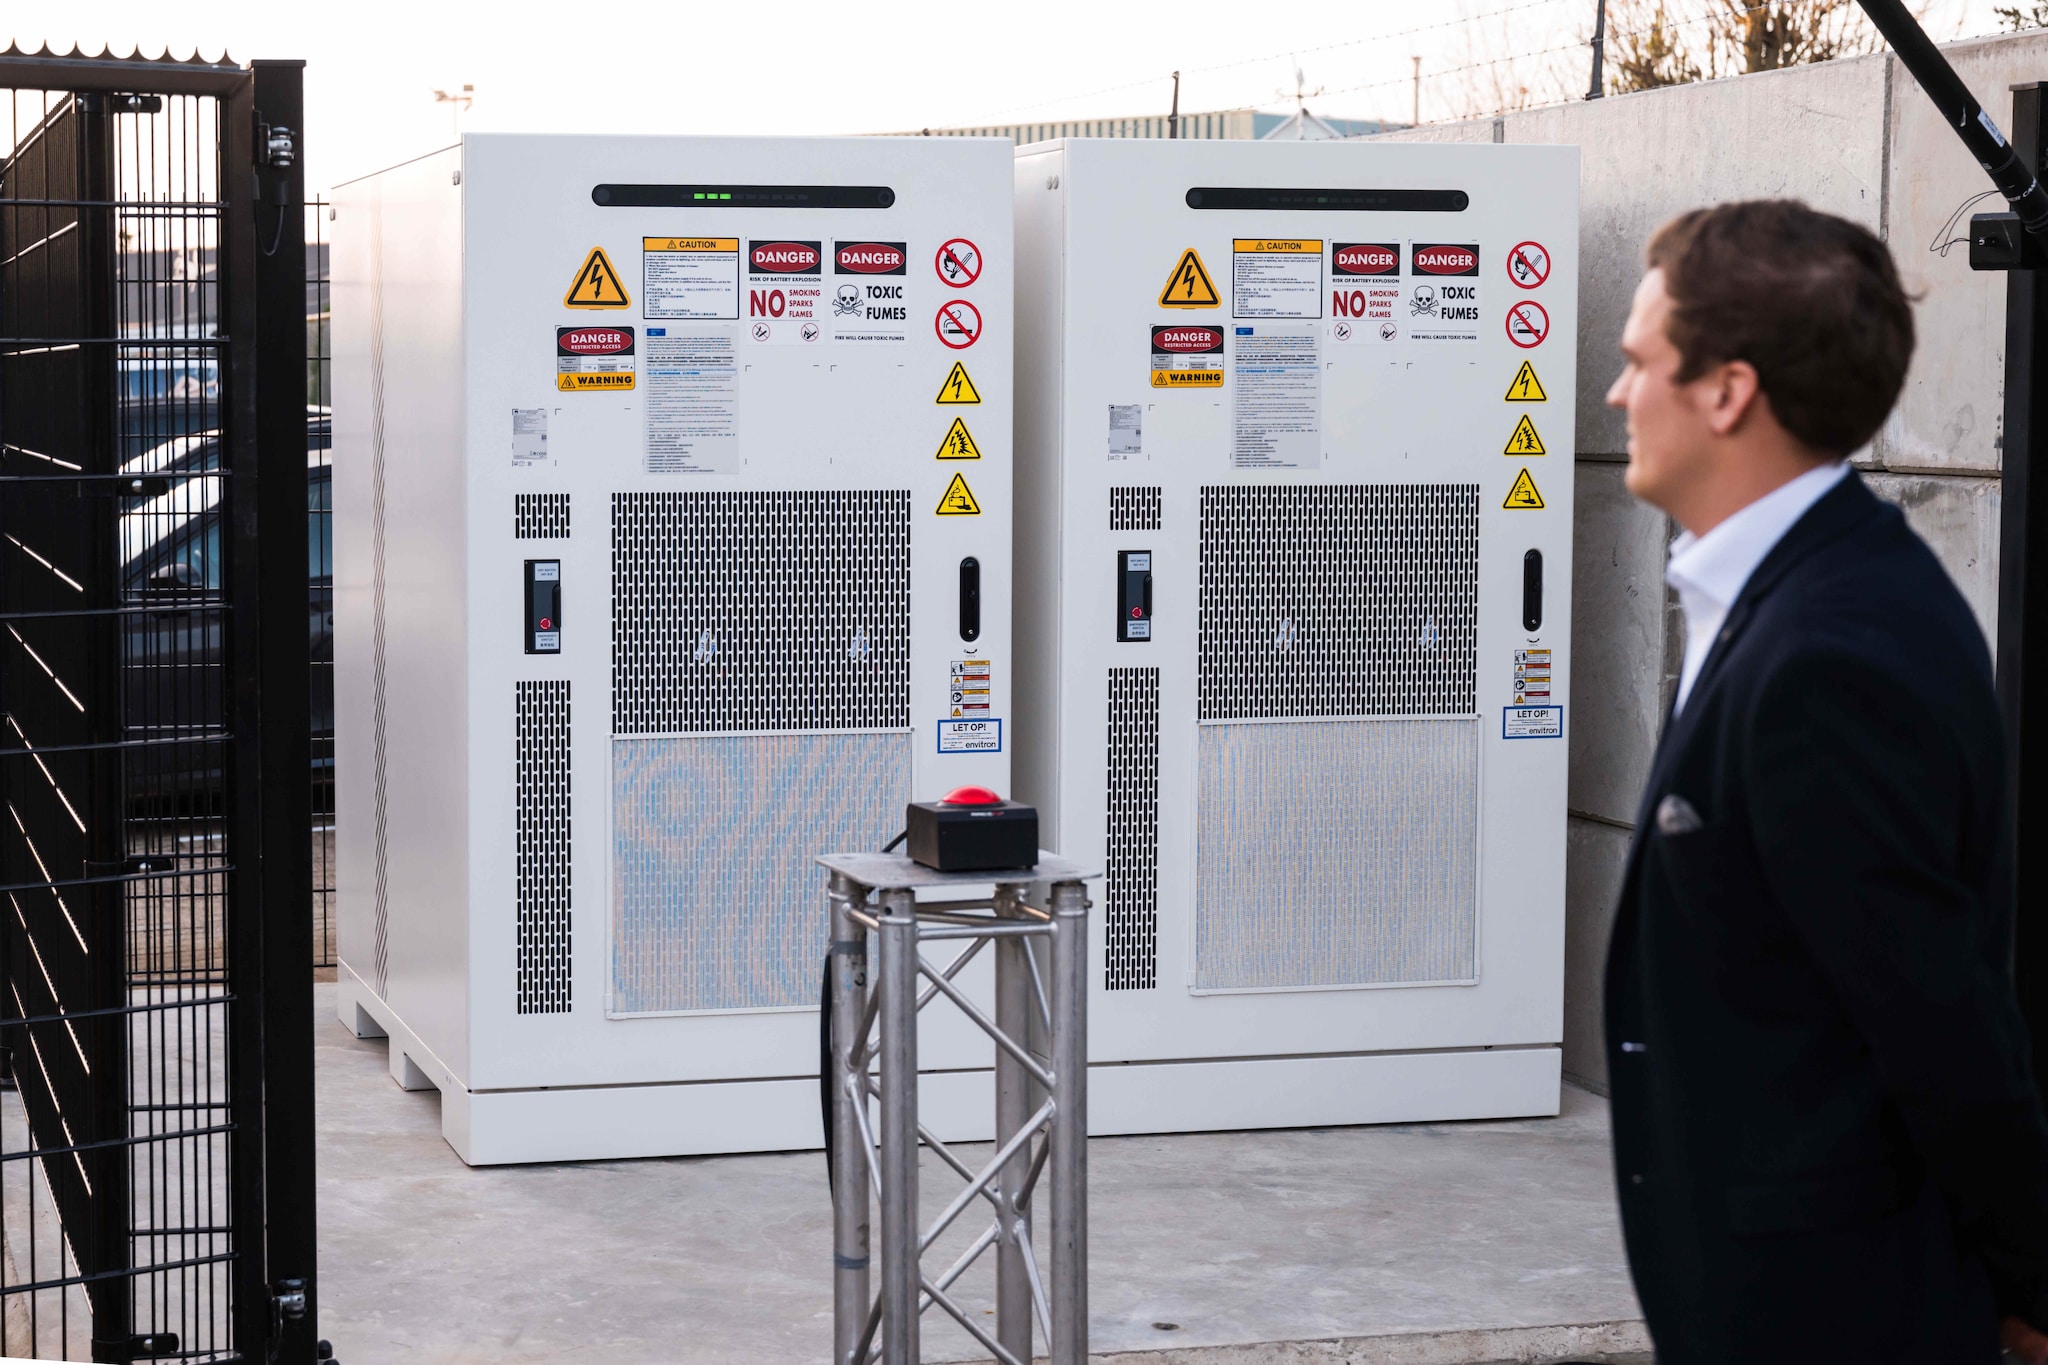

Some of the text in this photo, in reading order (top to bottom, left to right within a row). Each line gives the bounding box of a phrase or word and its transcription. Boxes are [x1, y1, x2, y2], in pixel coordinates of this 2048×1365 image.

[679, 240, 717, 249] CAUTION
[1267, 242, 1302, 250] CAUTION
[756, 252, 814, 263] DANGER
[842, 253, 900, 264] DANGER
[1338, 254, 1393, 265] DANGER
[1418, 255, 1472, 266] DANGER
[789, 289, 821, 297] SMOKING
[866, 286, 903, 299] TOXIC
[1441, 287, 1475, 299] TOXIC
[750, 289, 785, 318] NO
[1333, 290, 1366, 318] NO
[866, 307, 906, 320] FUMES
[1441, 307, 1479, 320] FUMES
[570, 334, 621, 343] DANGER
[1164, 332, 1212, 342] DANGER
[577, 376, 632, 384] WARNING
[1517, 710, 1532, 718] LET
[952, 723, 987, 732] LET OP!
